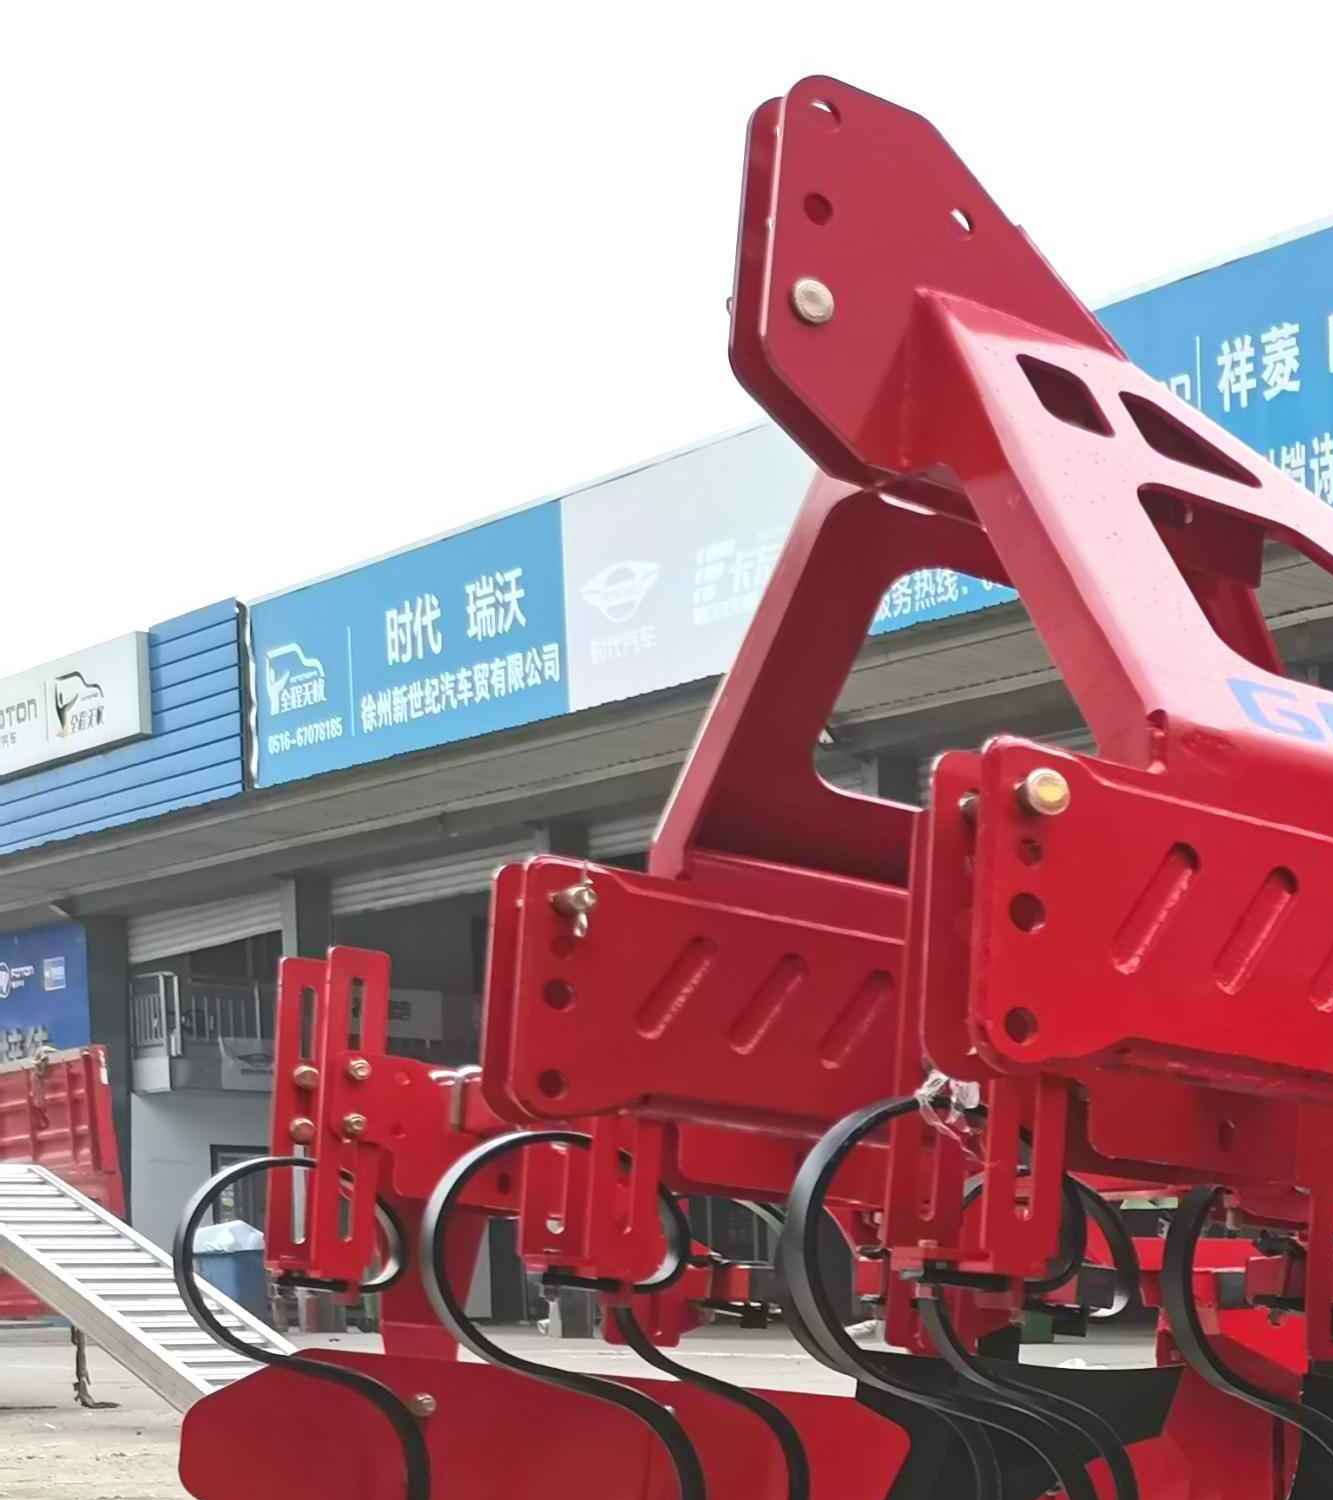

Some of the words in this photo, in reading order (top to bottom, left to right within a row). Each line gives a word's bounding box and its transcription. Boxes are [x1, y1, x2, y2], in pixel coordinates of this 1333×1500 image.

[1217, 322, 1301, 413] 祥菱
[385, 592, 443, 667] 时代
[464, 567, 527, 642] 瑞沃
[360, 642, 561, 734] 徐州新世纪汽车贸有限公司
